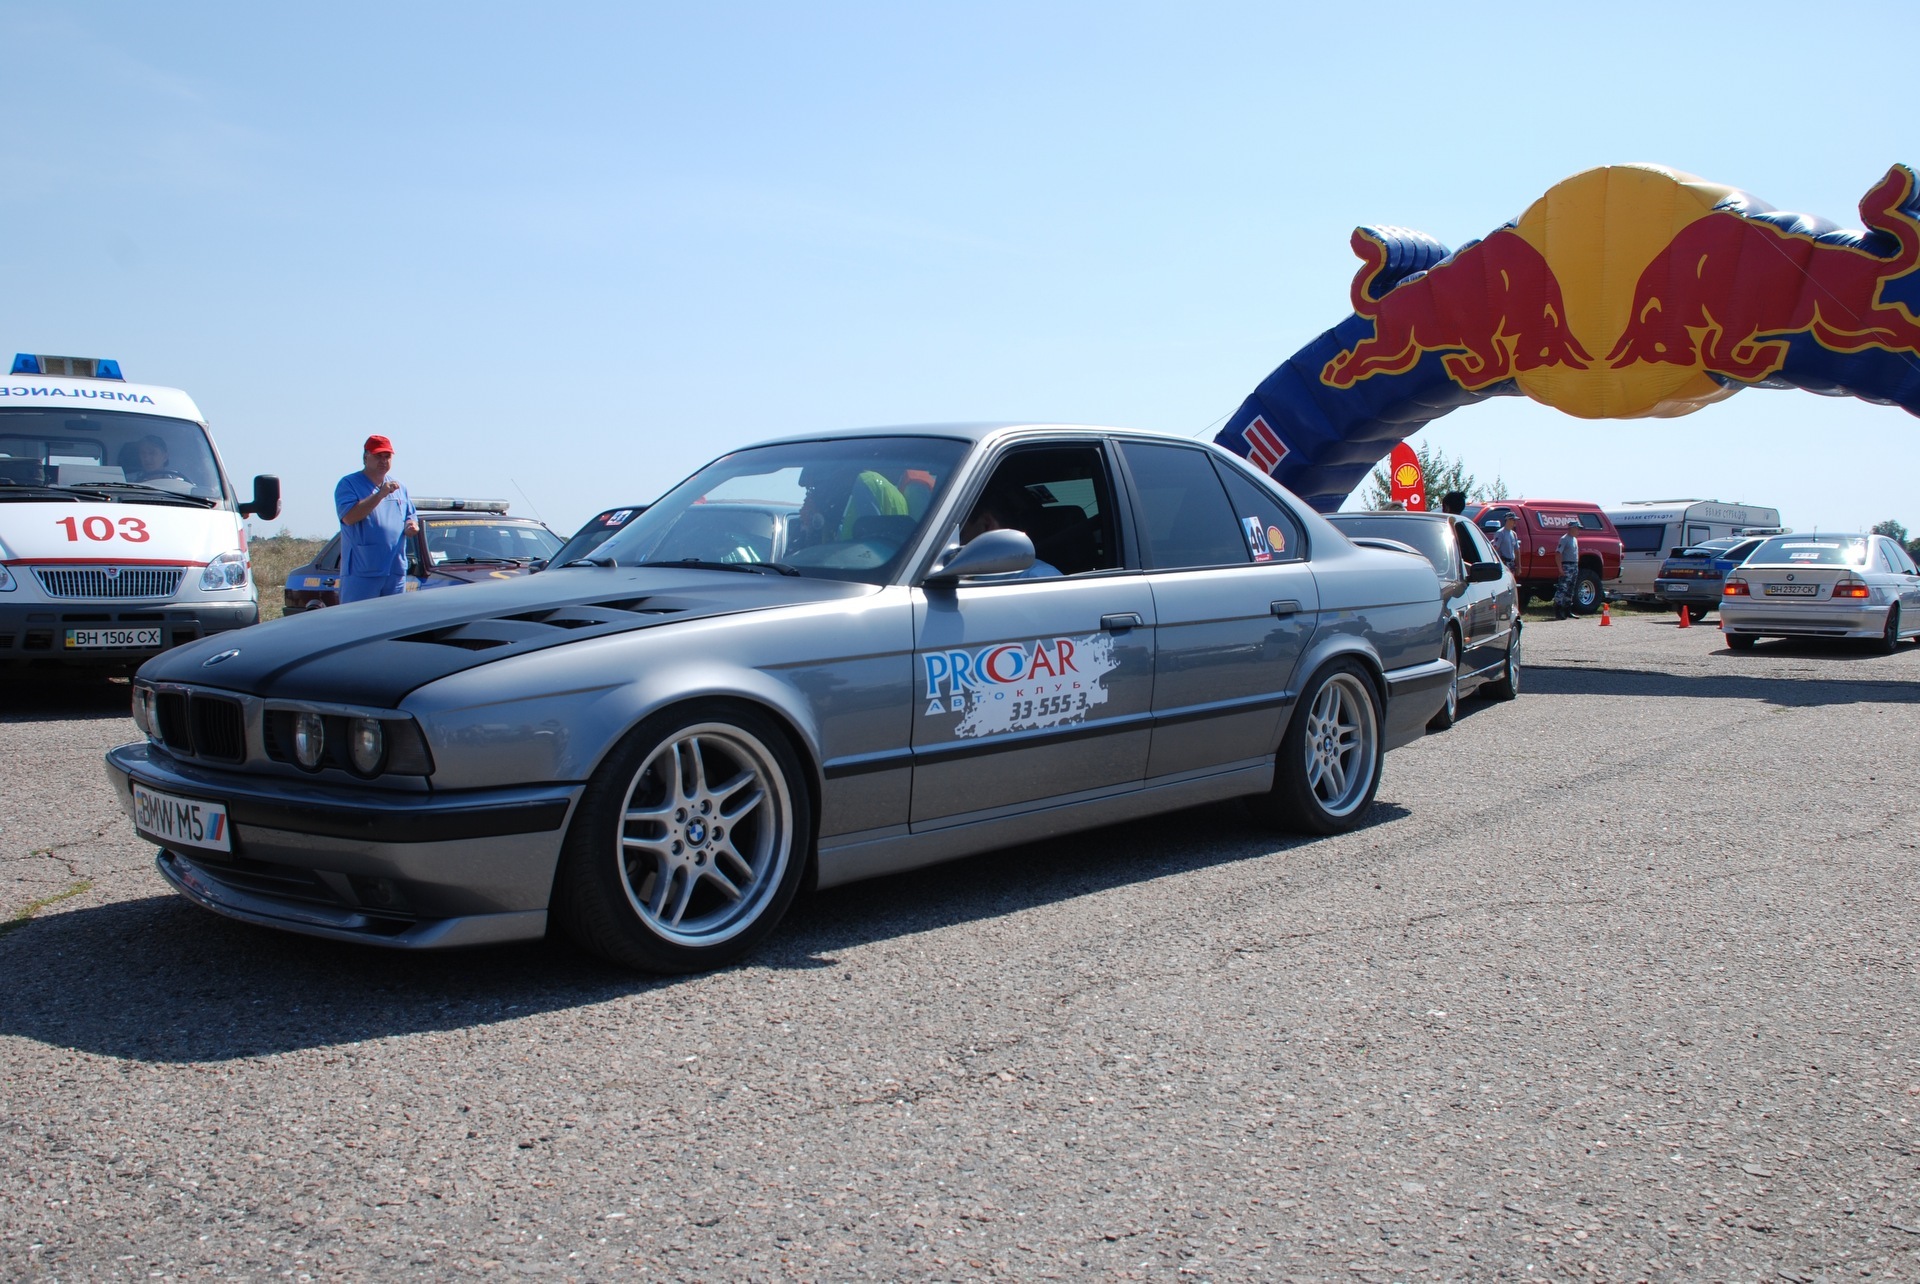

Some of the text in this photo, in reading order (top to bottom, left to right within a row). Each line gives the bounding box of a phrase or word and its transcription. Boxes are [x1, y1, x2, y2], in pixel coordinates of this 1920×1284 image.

[55, 515, 151, 543] 103
[1250, 526, 1266, 553] 40
[1783, 585, 1802, 594] 2327
[76, 630, 157, 645] BH 1506 CX
[140, 792, 205, 842] BMW M5
